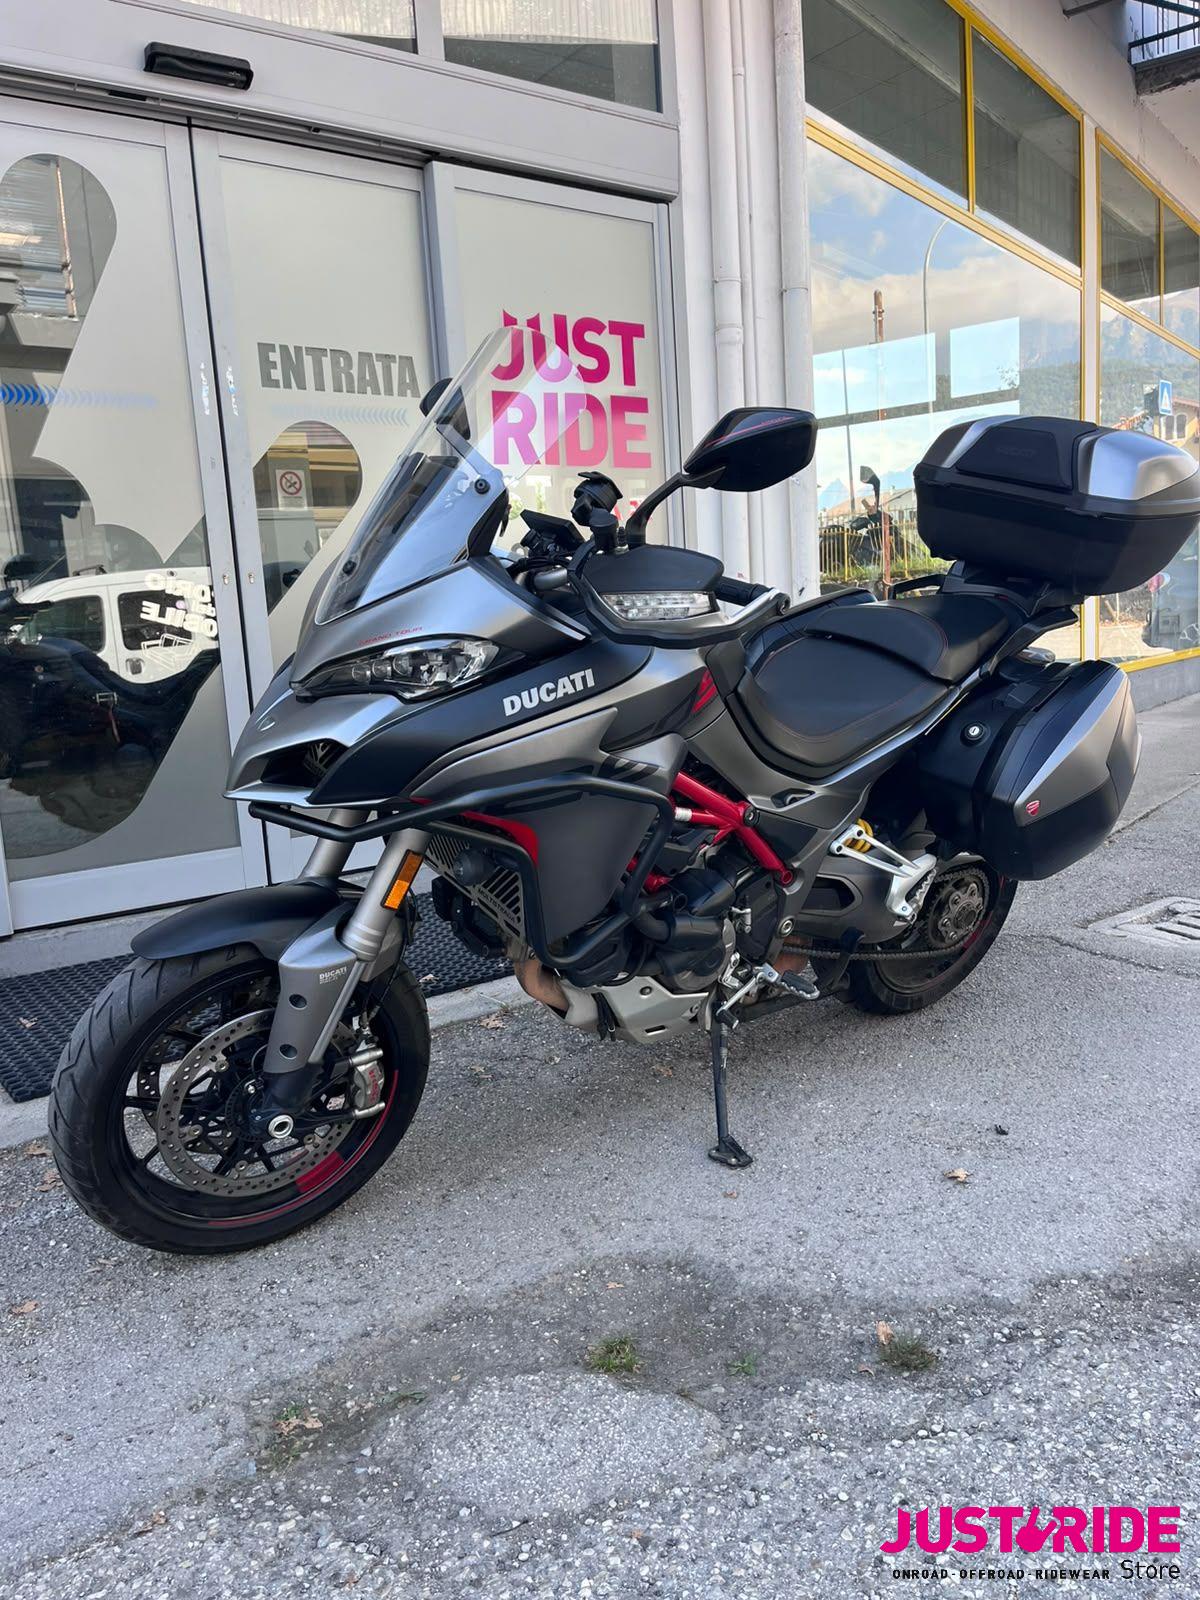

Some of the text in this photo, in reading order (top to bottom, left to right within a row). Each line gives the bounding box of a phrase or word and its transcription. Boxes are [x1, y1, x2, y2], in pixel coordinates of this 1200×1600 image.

[256, 342, 421, 398] ENTRATA
[491, 309, 646, 387] JUST
[491, 390, 652, 468] RIDE
[502, 668, 595, 717] DUCATI
[319, 966, 347, 979] DUCATI
